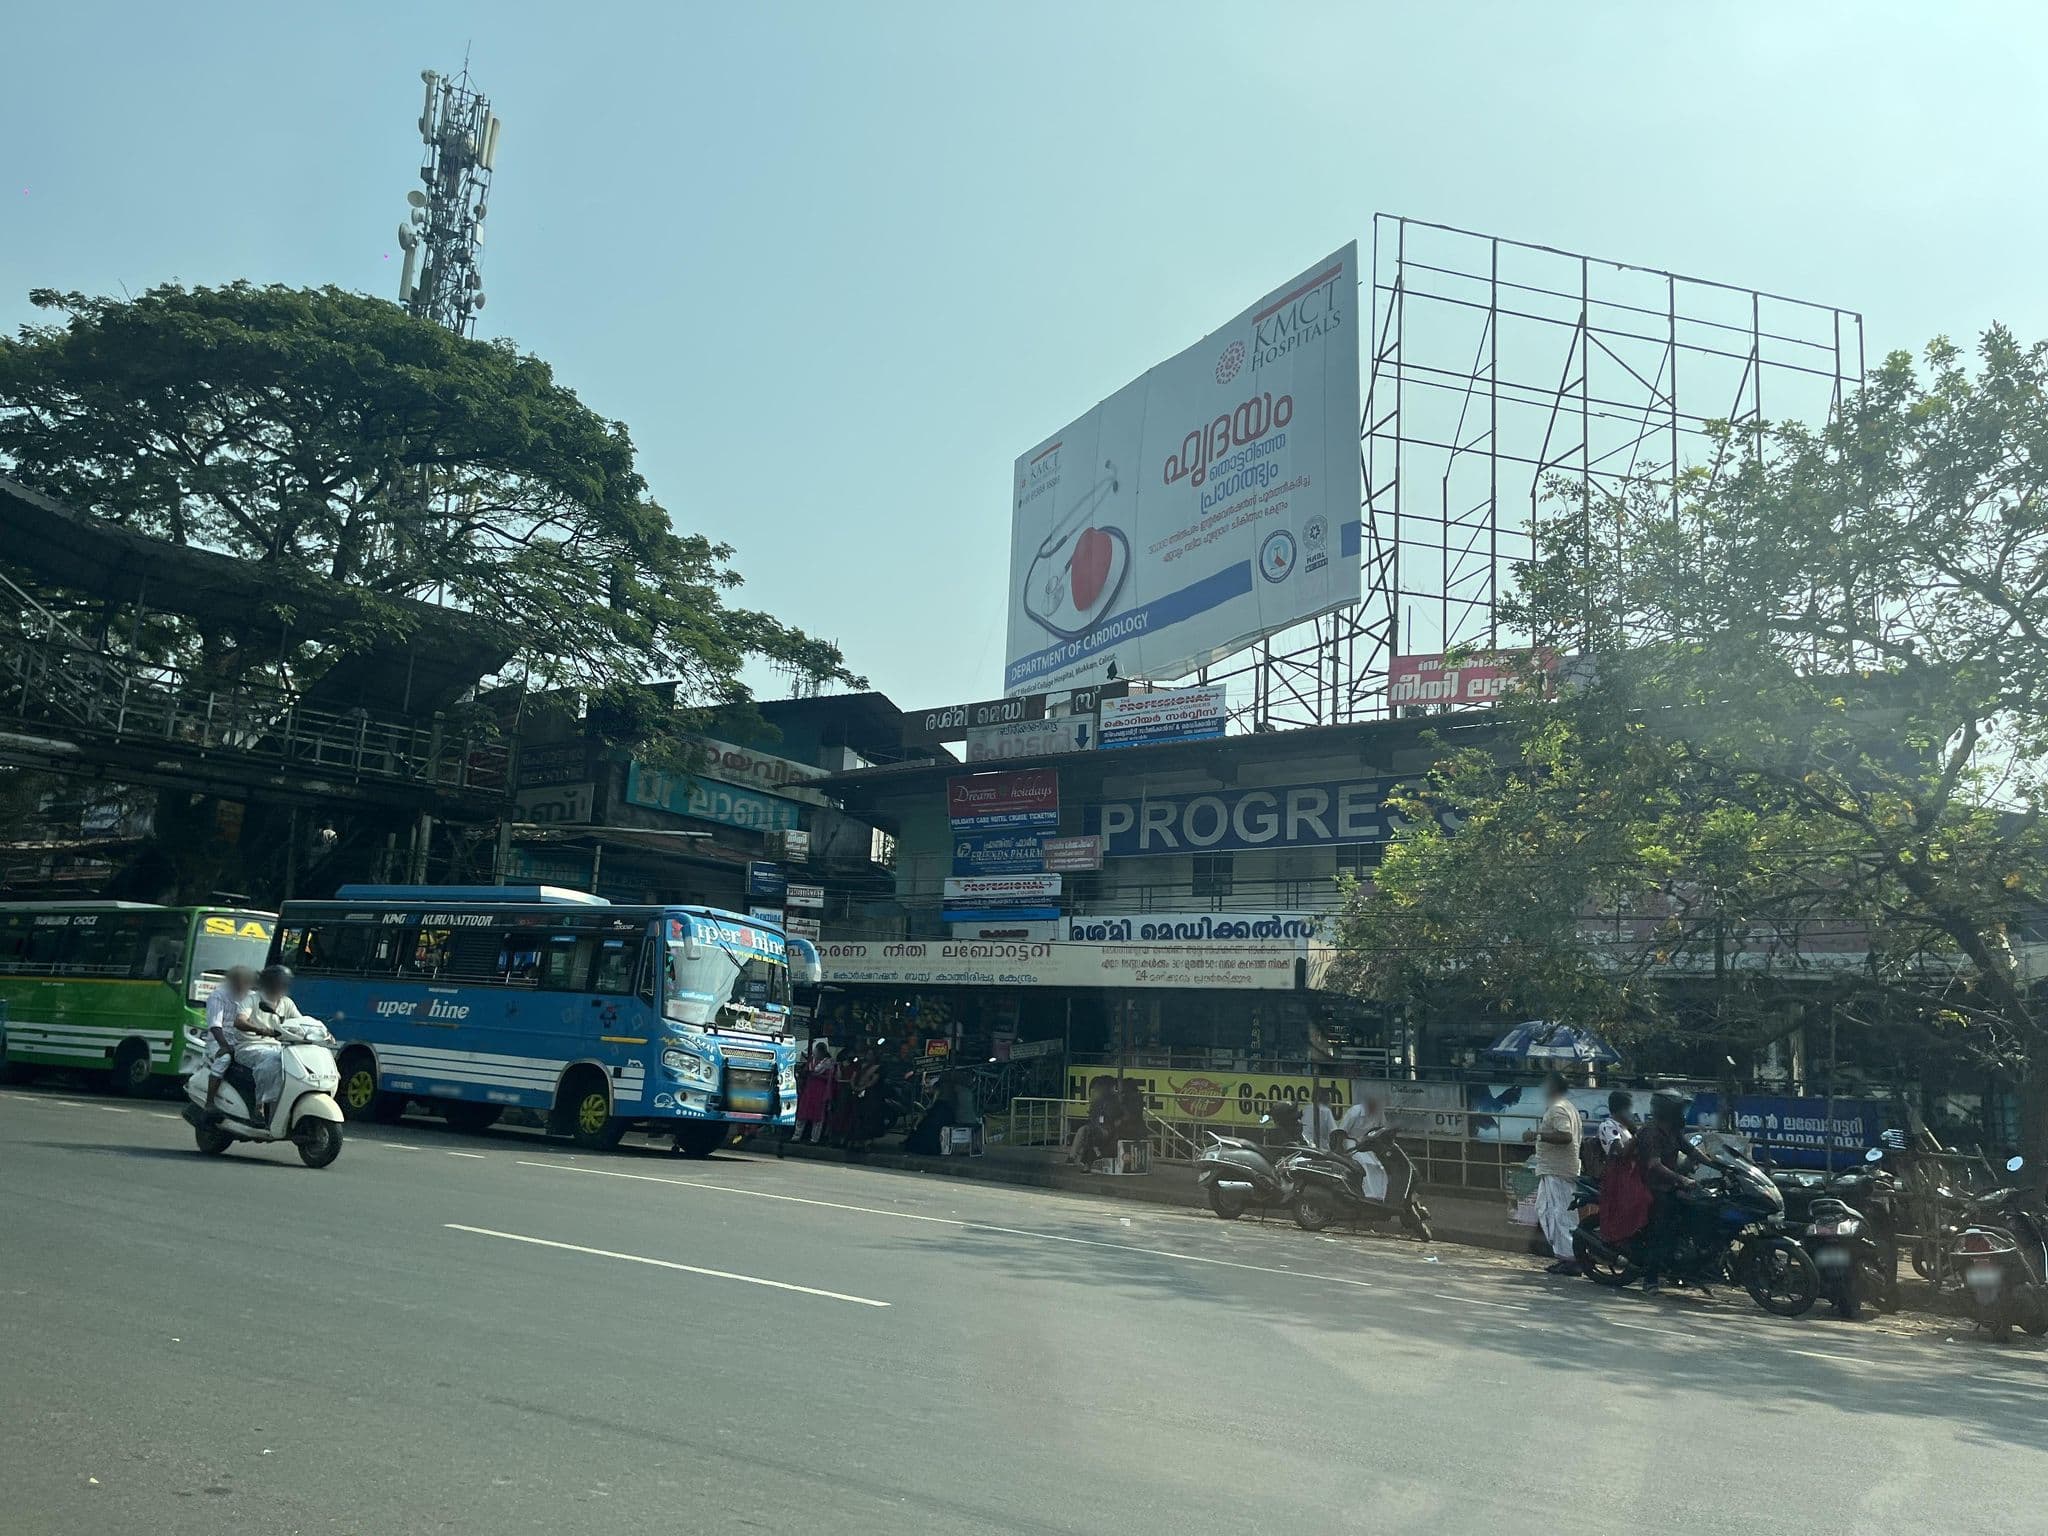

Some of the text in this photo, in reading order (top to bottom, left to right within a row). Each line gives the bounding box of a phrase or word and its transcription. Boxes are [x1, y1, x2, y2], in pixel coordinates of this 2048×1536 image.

[1254, 276, 1342, 353] KMCT
[1251, 310, 1341, 372] HOSPITALS
[1163, 391, 1293, 487] ഹൃദയം
[1011, 612, 1149, 681] DEPARTMENT OF CARDIOLOGY
[1390, 671, 1460, 701] നീതി
[1119, 693, 1212, 712] PROFESSIONAL
[1104, 714, 1161, 729] കൊറിയർ
[963, 881, 1045, 892] PROFESSIONAL
[382, 913, 406, 925] KING
[1071, 918, 1132, 942] രശ്മി
[883, 943, 927, 958] നീതി
[942, 943, 1051, 962] ലബോറട്ടറി
[1134, 969, 1146, 980] 24
